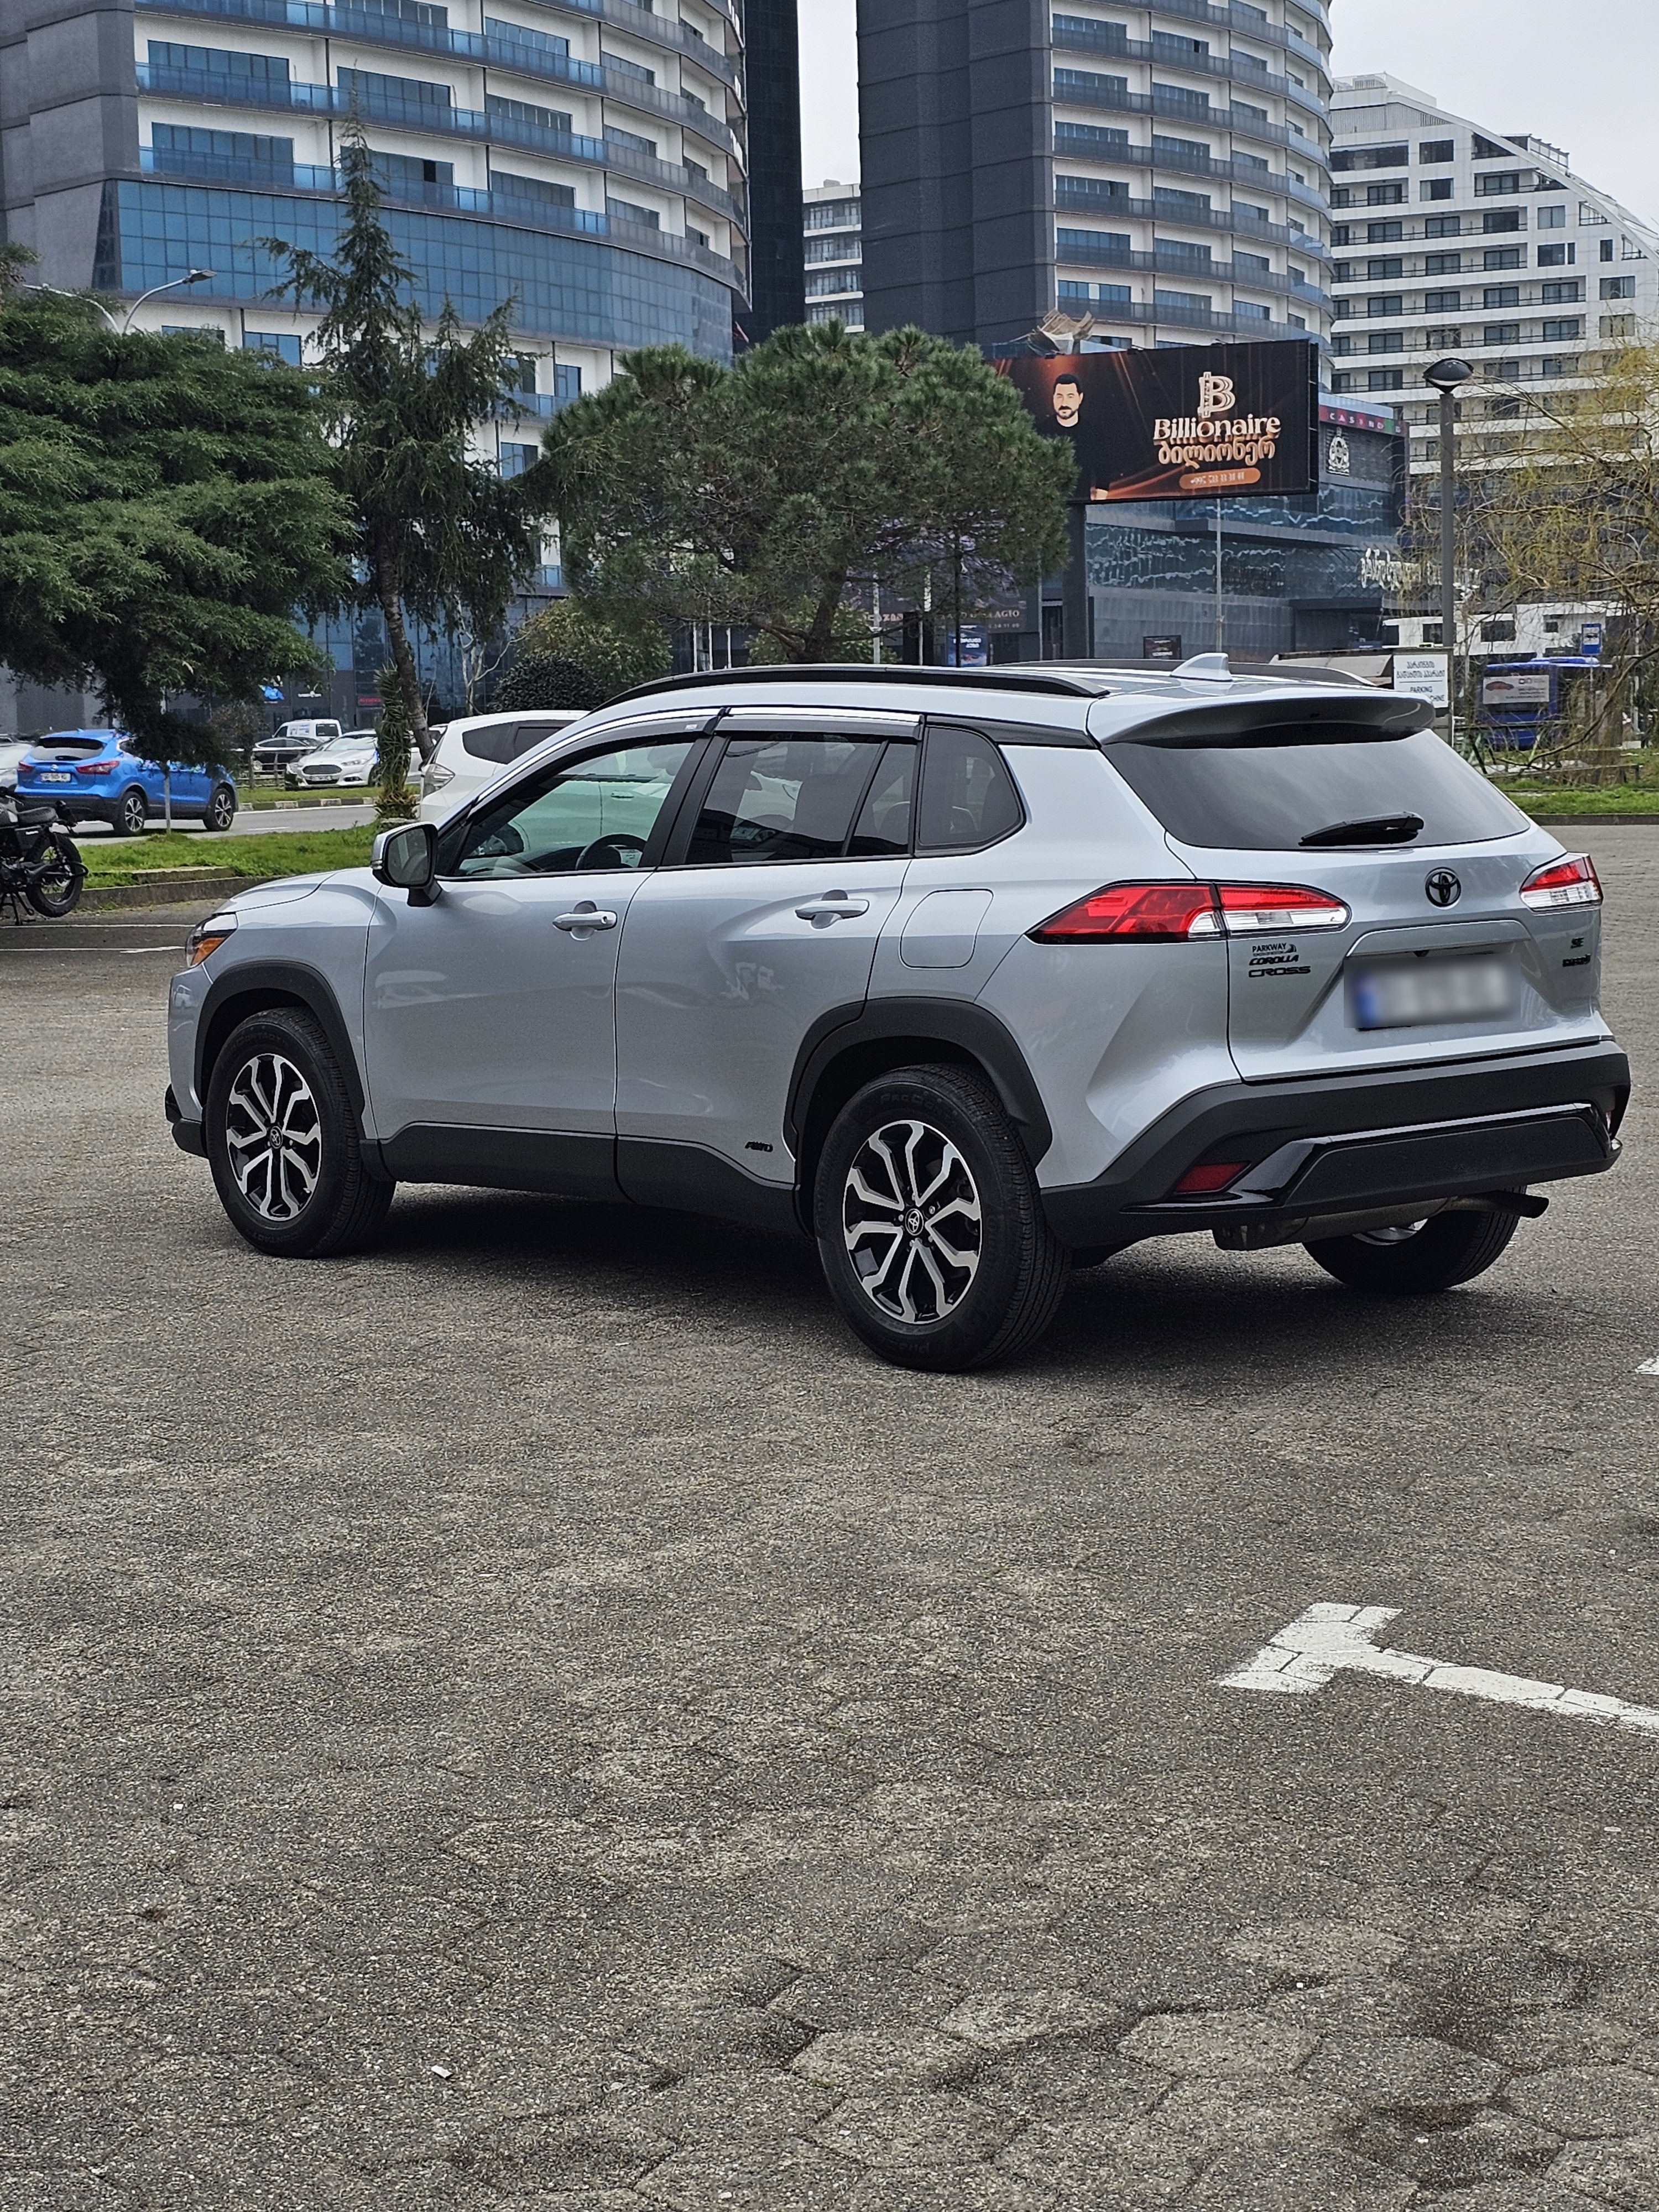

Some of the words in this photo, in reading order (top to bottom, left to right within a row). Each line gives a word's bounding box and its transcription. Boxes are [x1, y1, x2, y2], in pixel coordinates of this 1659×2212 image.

[1153, 414, 1281, 442] Billionaire
[1159, 436, 1275, 469] ბილიონერ
[1252, 942, 1287, 953] PARKWAY
[1249, 954, 1299, 966] COROLLA
[1249, 966, 1311, 978] CROSS
